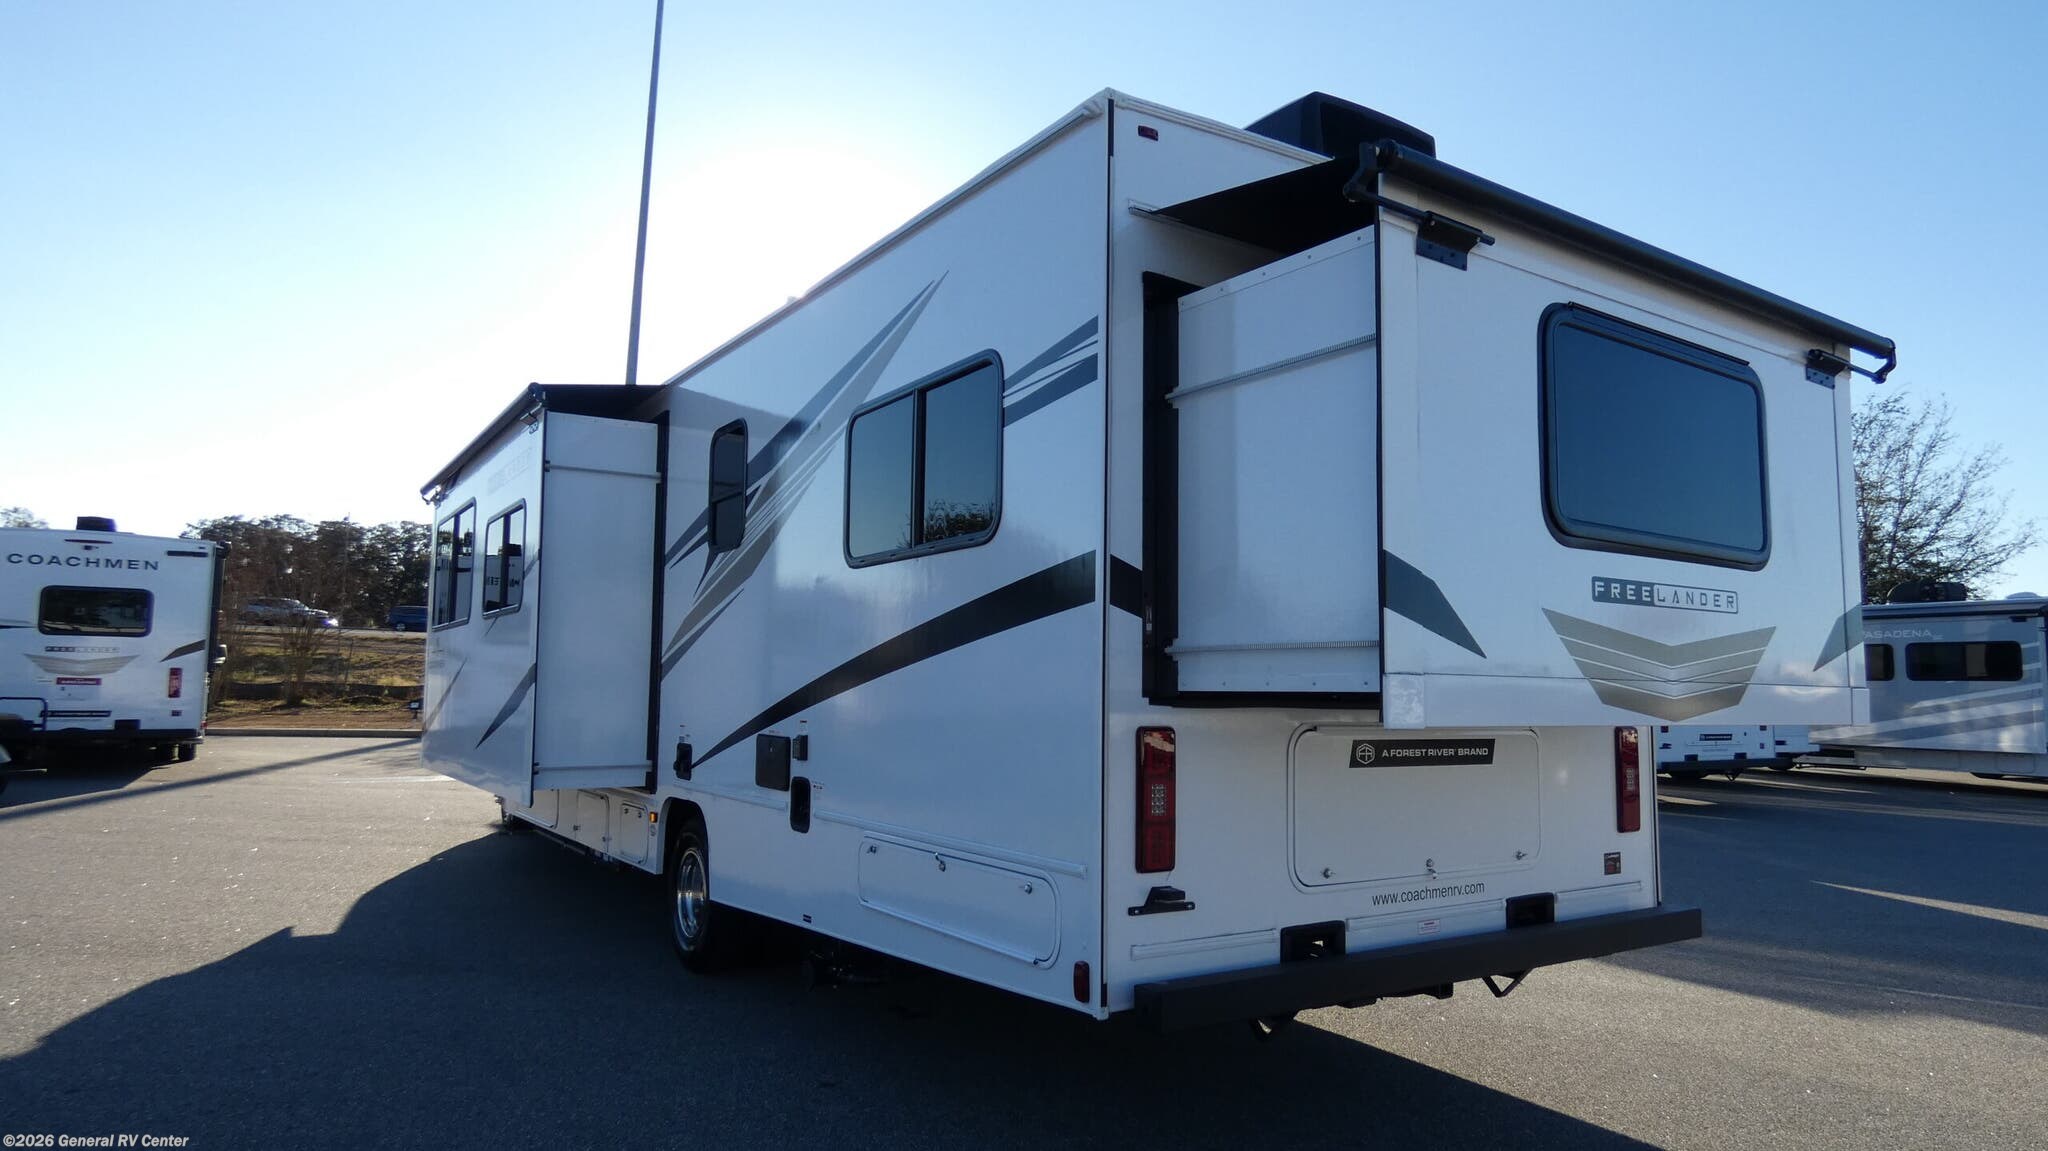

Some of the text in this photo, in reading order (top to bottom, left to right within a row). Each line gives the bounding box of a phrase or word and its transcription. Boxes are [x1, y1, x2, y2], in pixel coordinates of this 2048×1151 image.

[7, 553, 159, 571] COACHMEN
[1594, 581, 1735, 609] FREELANDER
[1382, 749, 1389, 757] A
[1390, 748, 1427, 757] FOREST
[1458, 748, 1489, 756] BRAND
[1372, 882, 1485, 906] www.coachmenrv.com
